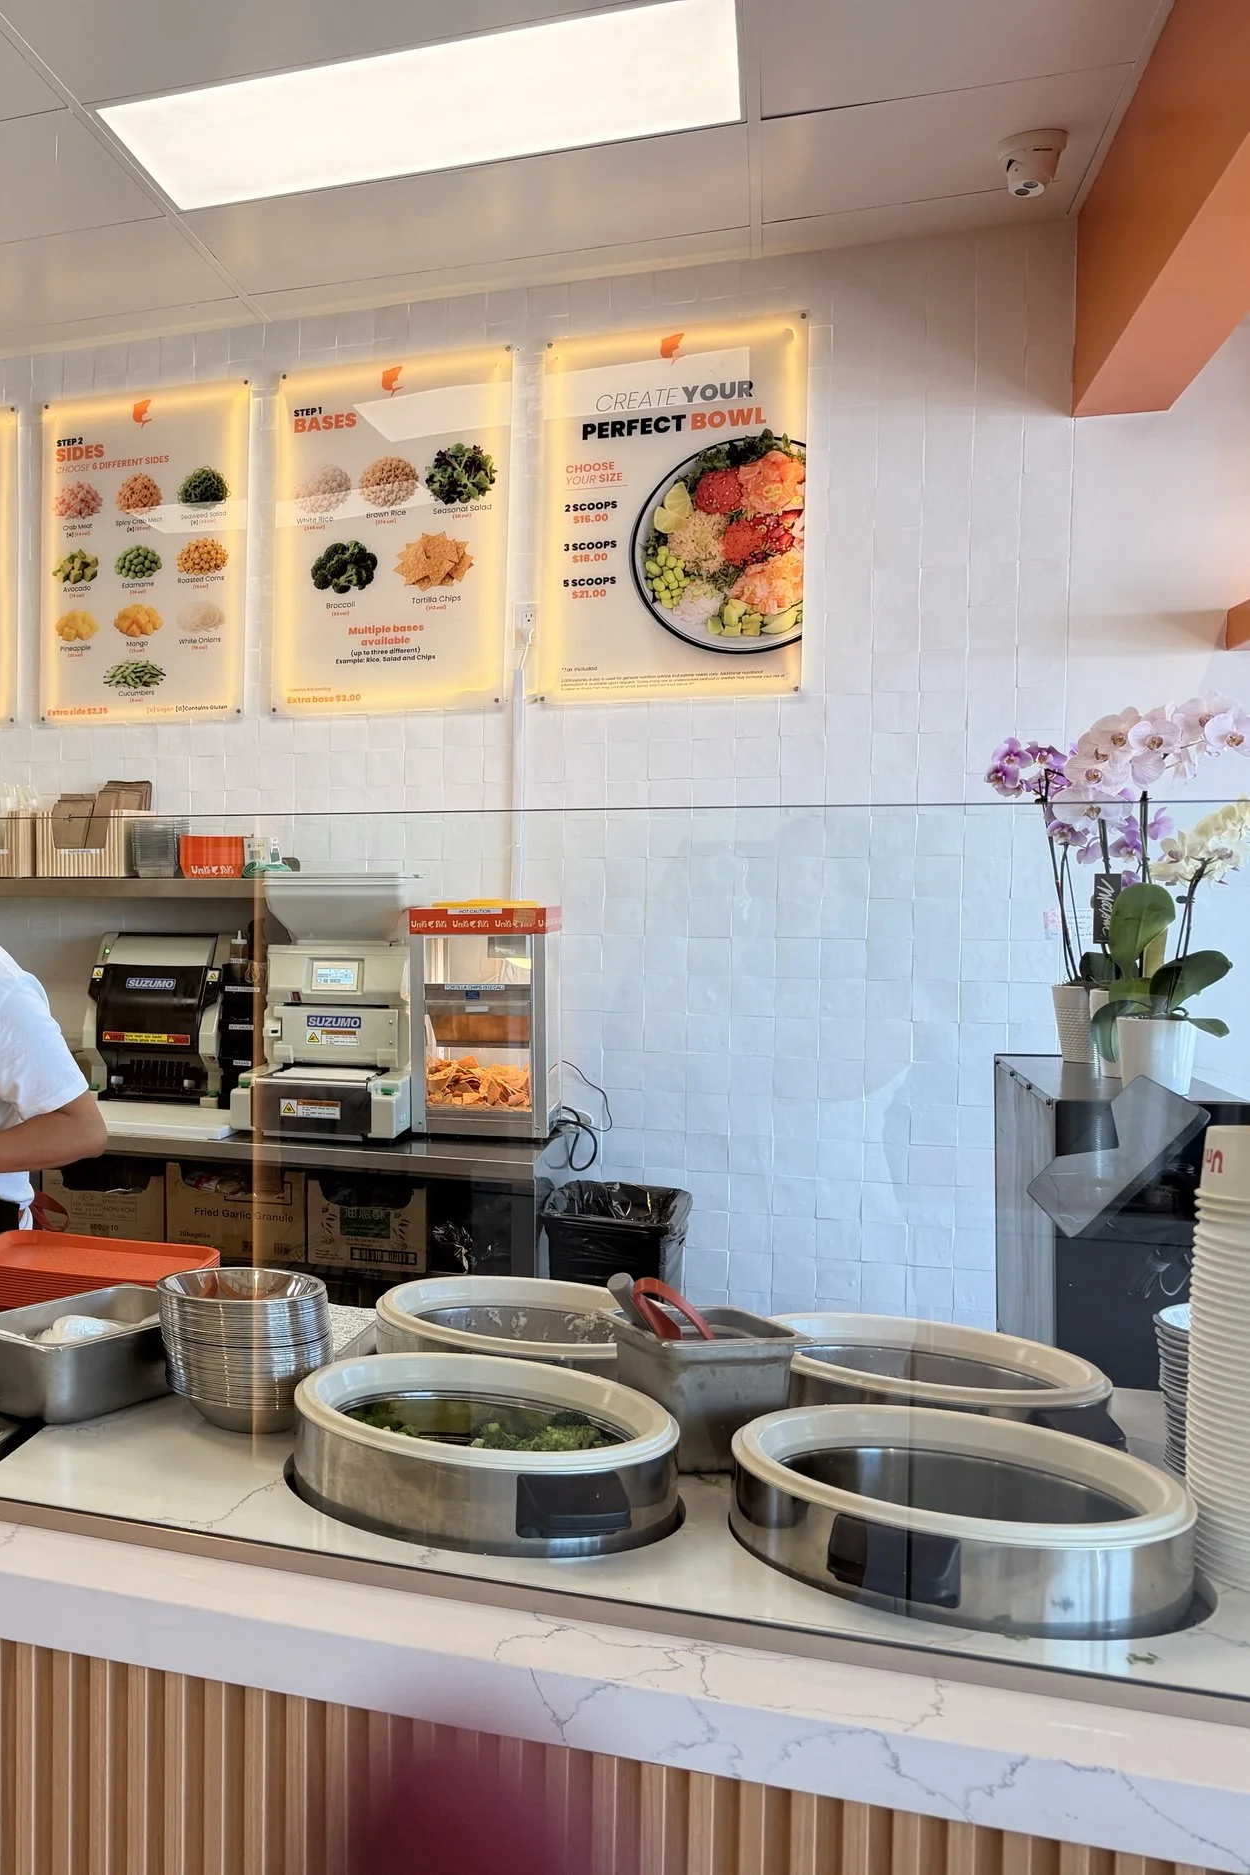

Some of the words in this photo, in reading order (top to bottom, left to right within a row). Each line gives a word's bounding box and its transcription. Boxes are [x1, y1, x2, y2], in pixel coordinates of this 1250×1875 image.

[596, 388, 679, 412] CREATE
[682, 380, 754, 403] YOUR
[293, 408, 316, 418] STEP
[317, 407, 323, 415] 1
[293, 412, 357, 433] BASES
[582, 414, 686, 441] PERFECT
[691, 406, 767, 431] BOWL
[56, 439, 77, 448] STEP
[77, 437, 83, 446] 2
[55, 443, 105, 463] SIDES
[55, 464, 90, 475] CHOOSE
[92, 462, 97, 470] 6
[99, 458, 144, 470] DIFFERENT
[145, 455, 170, 465] SIDES
[565, 461, 615, 474] CHOOSE
[565, 474, 597, 486] YOUR
[598, 472, 623, 483] SIZE
[432, 505, 468, 515] Seasonal
[470, 503, 492, 512] Salad
[564, 504, 571, 513] 2
[572, 501, 618, 512] SCOOPS
[180, 512, 208, 521] Seaweed
[297, 516, 316, 525] White
[317, 515, 334, 523] Rice
[366, 511, 389, 520] Brown
[391, 508, 406, 517] Rice
[573, 513, 609, 525] $16.00
[62, 523, 77, 531] Crab
[78, 522, 93, 531] Meat
[115, 519, 131, 527] Spicy
[148, 516, 163, 524] Meat
[563, 543, 570, 552] 3
[571, 540, 617, 551] SCOOPS
[572, 552, 608, 564] $18.00
[121, 581, 155, 589] Edamame
[177, 576, 204, 584] Roasted
[563, 579, 570, 588] 5
[571, 576, 617, 587] SCOOPS
[63, 585, 92, 593] Avocado
[571, 589, 607, 600] $21.00
[412, 596, 438, 605] Tortilla
[439, 593, 461, 605] Chips
[326, 601, 355, 610] Broccoli
[348, 624, 391, 637] Multiple
[392, 622, 424, 633] bases
[126, 640, 149, 648] Mango
[178, 637, 198, 645] White
[198, 636, 222, 644] Onions
[361, 634, 411, 647] available
[60, 644, 92, 653] Pineapple
[350, 650, 362, 658] (up
[370, 648, 389, 656] three
[389, 646, 421, 656] different)
[335, 656, 365, 665] Example:
[366, 656, 382, 664] Rice,
[382, 654, 402, 663] Salad
[402, 654, 415, 662] and
[416, 653, 436, 662] Chips
[118, 689, 155, 698] Cucumbers
[287, 695, 311, 704] Extra
[312, 694, 335, 703] base
[335, 693, 362, 703] $3.00
[47, 708, 70, 717] Extra
[70, 708, 86, 717] side
[86, 707, 108, 716] $2.25
[127, 979, 175, 989] SUZUMO
[308, 1016, 361, 1028] SUZUMO
[194, 1207, 219, 1217] Fried
[221, 1209, 252, 1221] Garlic
[253, 1211, 294, 1223] Granule
